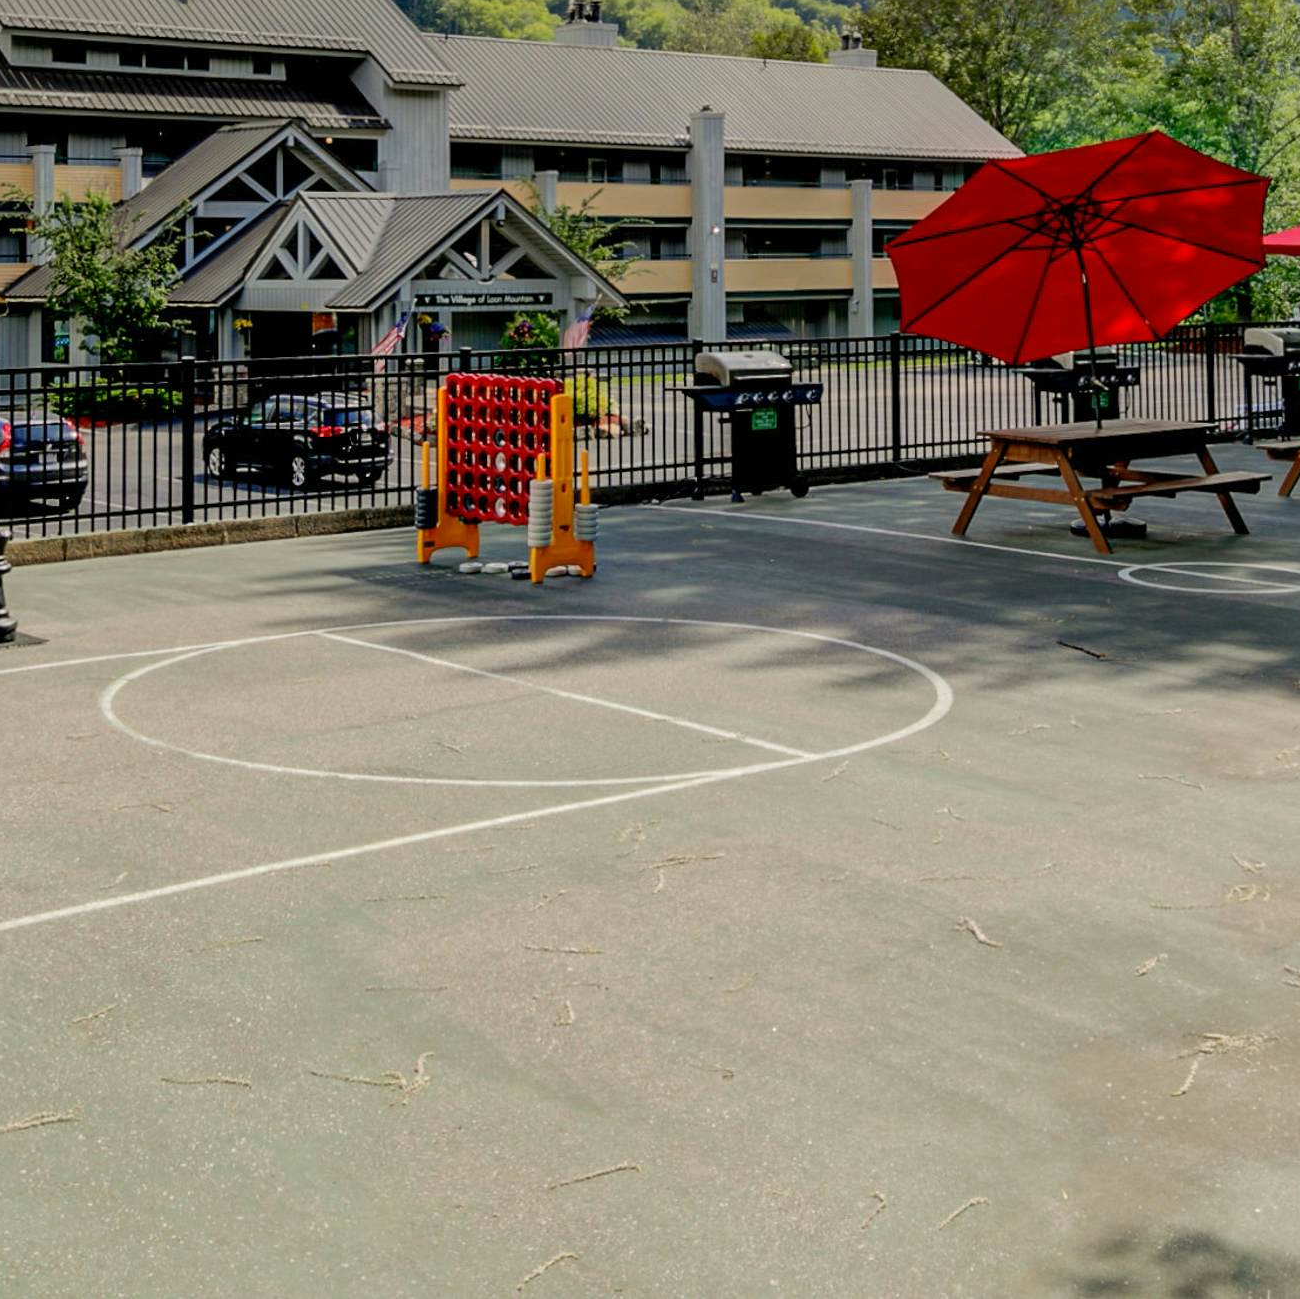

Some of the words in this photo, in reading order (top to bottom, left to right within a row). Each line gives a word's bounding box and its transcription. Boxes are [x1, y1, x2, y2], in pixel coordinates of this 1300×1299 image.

[436, 295, 449, 303] The
[450, 295, 476, 305] Village
[477, 295, 485, 303] of
[486, 295, 502, 303] Loon
[504, 295, 534, 303] Mountain
